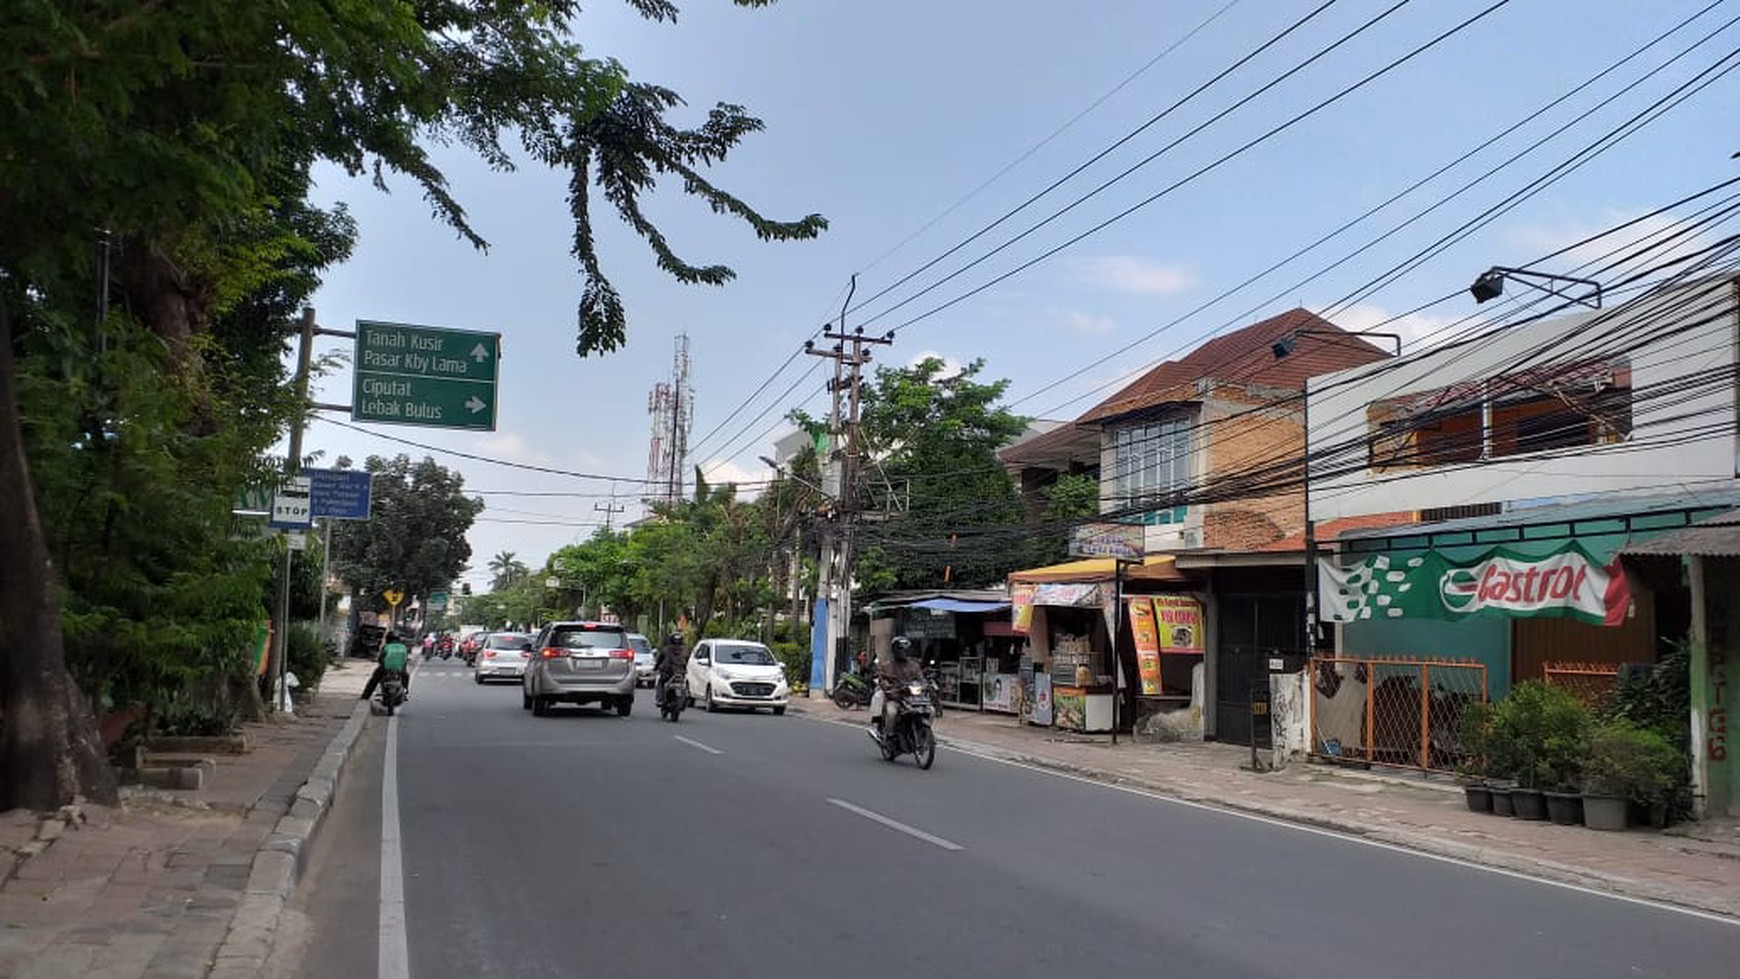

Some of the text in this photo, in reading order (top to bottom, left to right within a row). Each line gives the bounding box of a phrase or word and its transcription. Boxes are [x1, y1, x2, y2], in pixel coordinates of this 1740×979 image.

[365, 330, 443, 351] Tanah Kusir
[365, 350, 467, 373] Pasar Kby Lama
[362, 378, 411, 397] Ciputat
[361, 399, 442, 419] Lebak Bulus
[276, 506, 308, 516] STOP
[1477, 563, 1587, 604] Castrol
